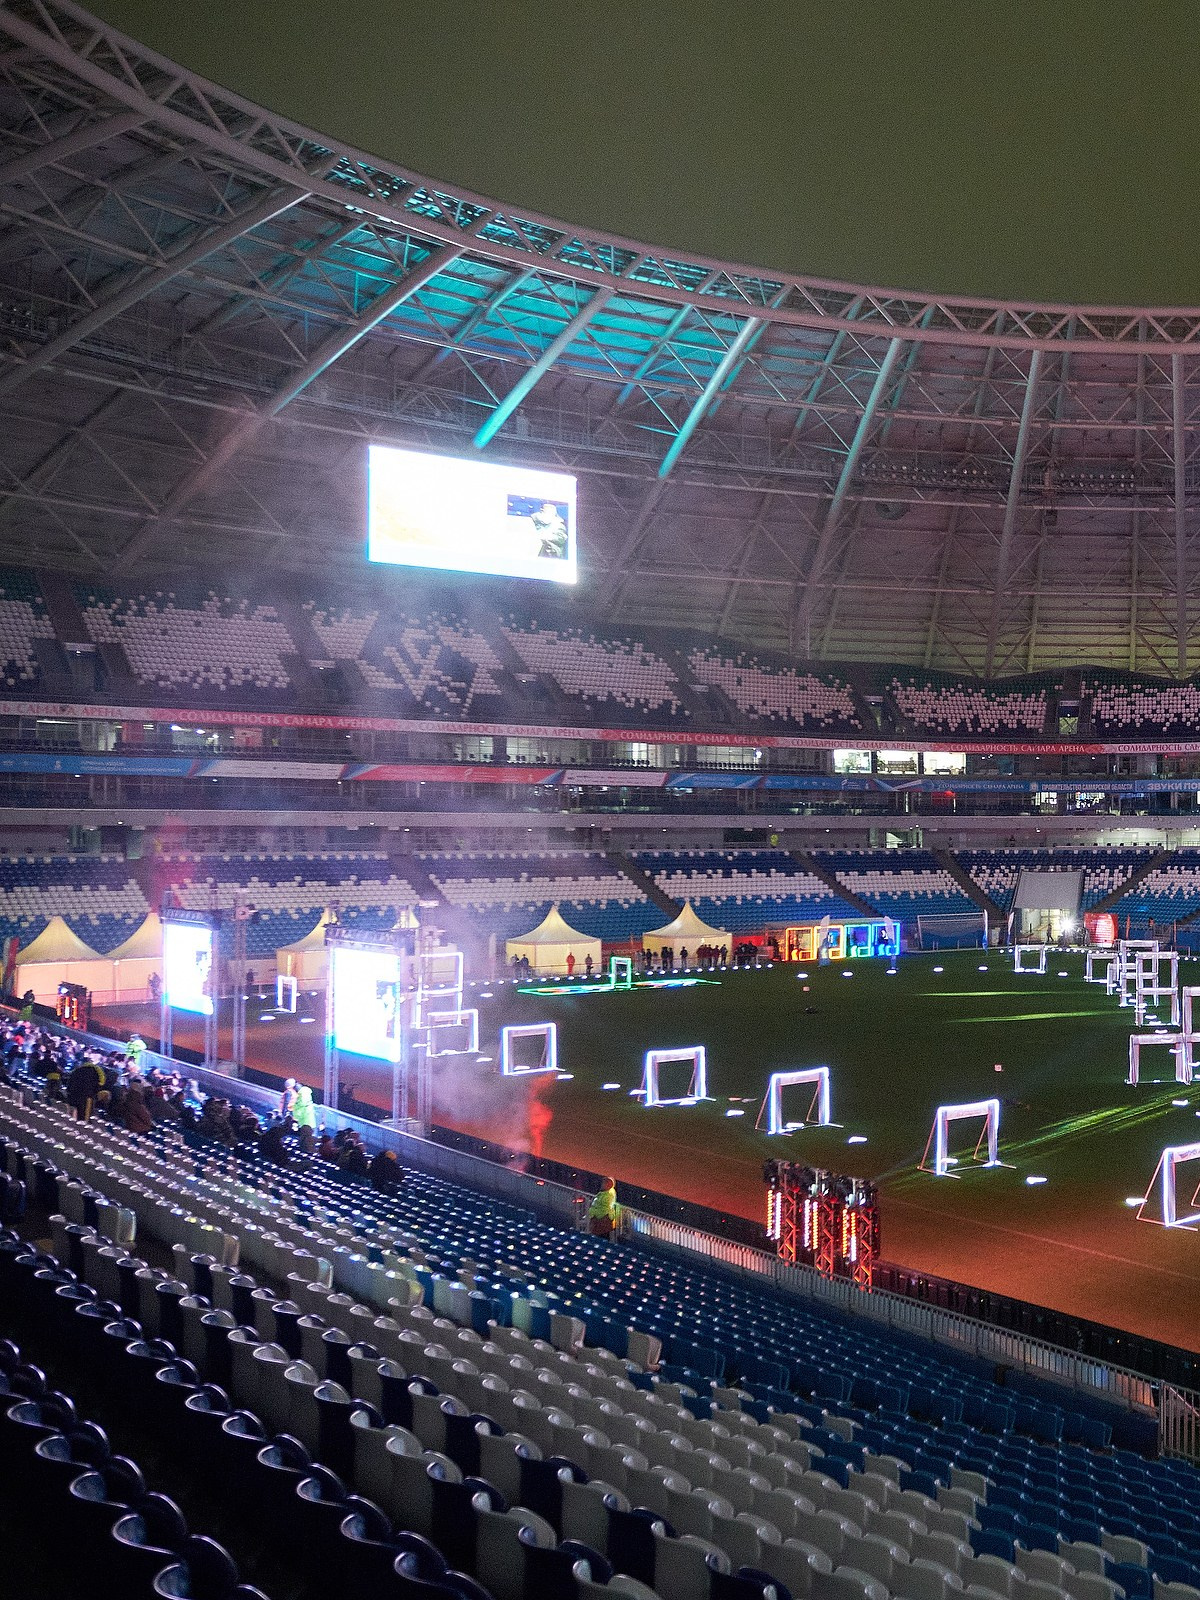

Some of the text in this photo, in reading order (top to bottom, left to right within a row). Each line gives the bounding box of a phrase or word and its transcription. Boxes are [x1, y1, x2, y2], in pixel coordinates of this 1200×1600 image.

[178, 711, 372, 729] СОЛИДАРНОСТЬ САМАРА АРЕНА
[419, 721, 582, 738] СОЛИДАРНОСТЬ САМАРА АРЕНА
[620, 731, 759, 745] СОЛИДАРНОСТЬ САМАРА АРЕНА
[792, 739, 916, 750] СОЛИДАРНОСТЬ САМАРА АРЕНА
[951, 744, 1085, 752] СОЛИДАРНОСТЬ САМАРА АРЕНА
[1118, 743, 1182, 752] СОЛИДАРНОСТЬ
[1147, 783, 1182, 791] ЗВУКИ
